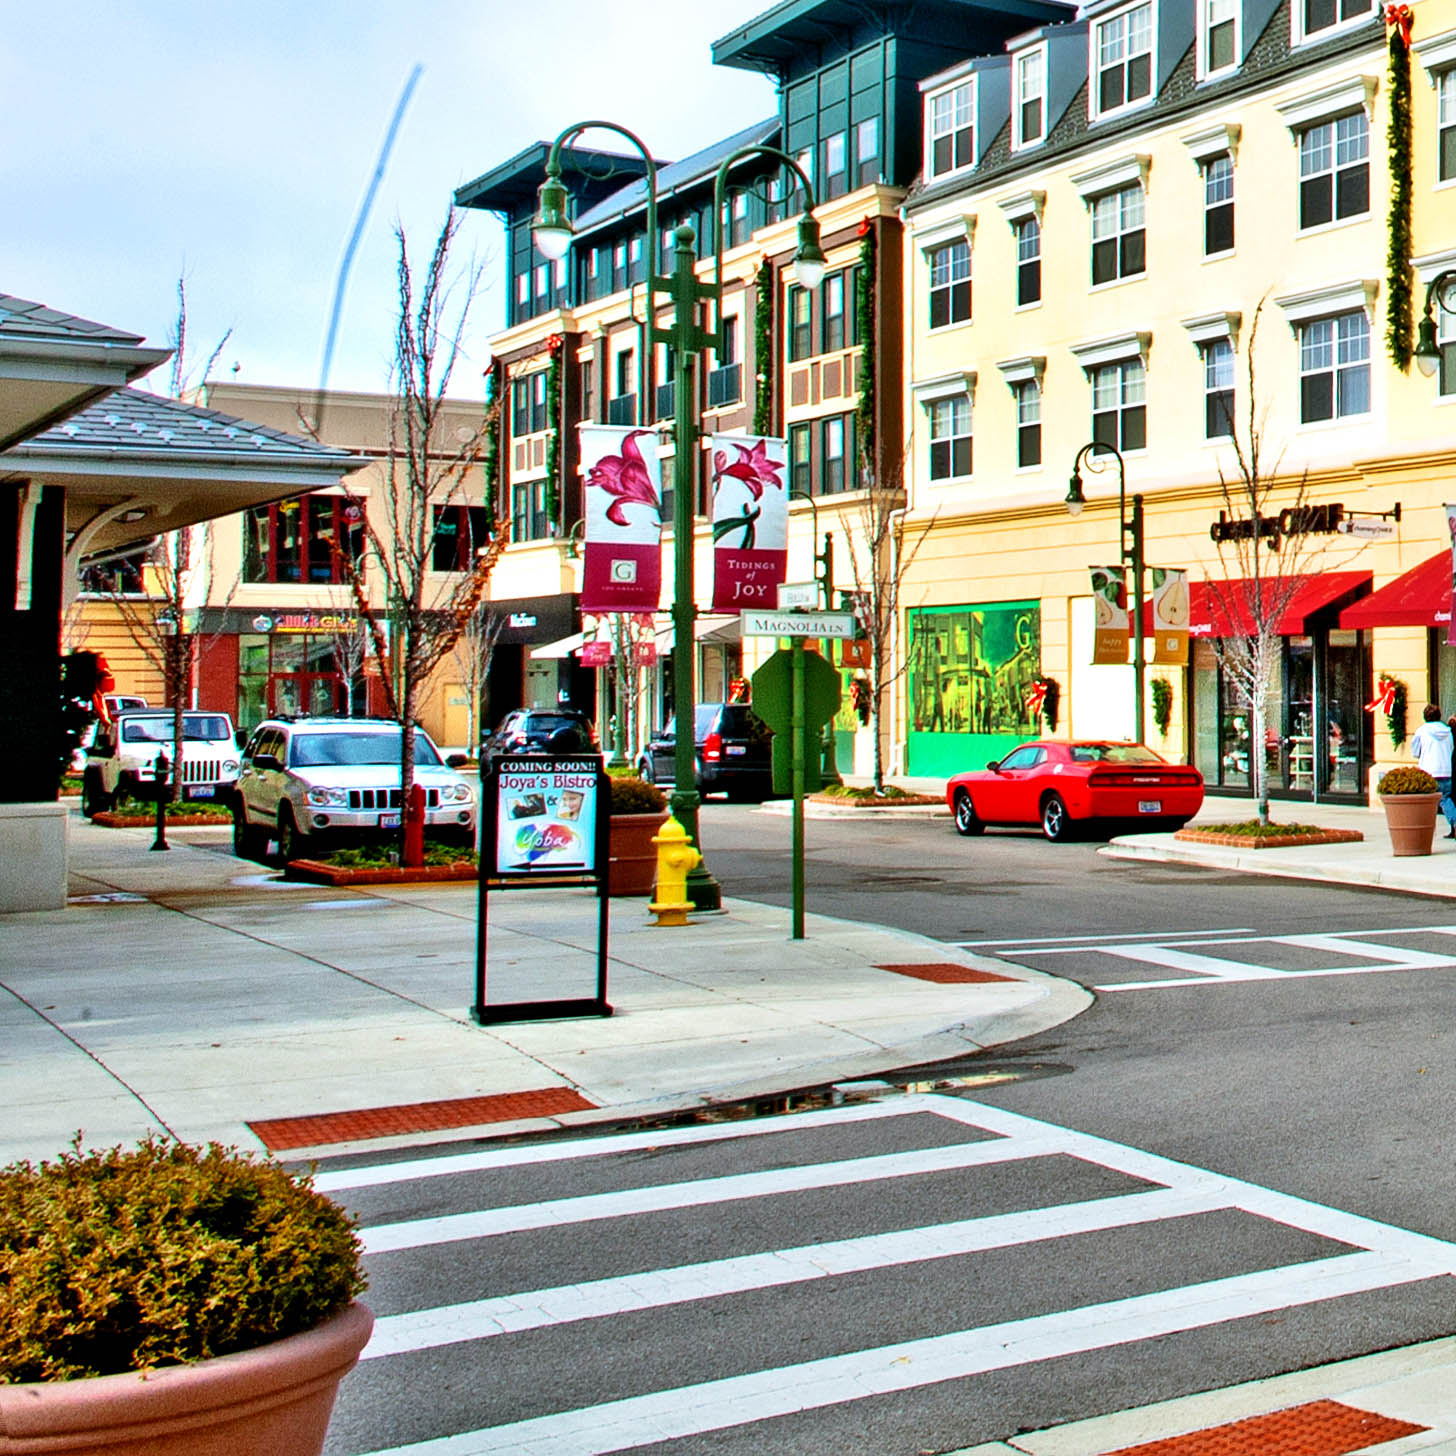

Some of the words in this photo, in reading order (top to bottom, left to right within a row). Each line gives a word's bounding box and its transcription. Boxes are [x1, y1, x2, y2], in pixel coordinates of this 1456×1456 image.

[727, 559, 776, 570] TIDINGS
[745, 570, 756, 581] of
[732, 581, 768, 600] JOY
[754, 619, 828, 633] MAGNOLIA
[500, 761, 552, 772] COMING
[554, 761, 596, 772] SOON!!
[500, 775, 549, 792] Joya's
[554, 775, 596, 789] Bistro
